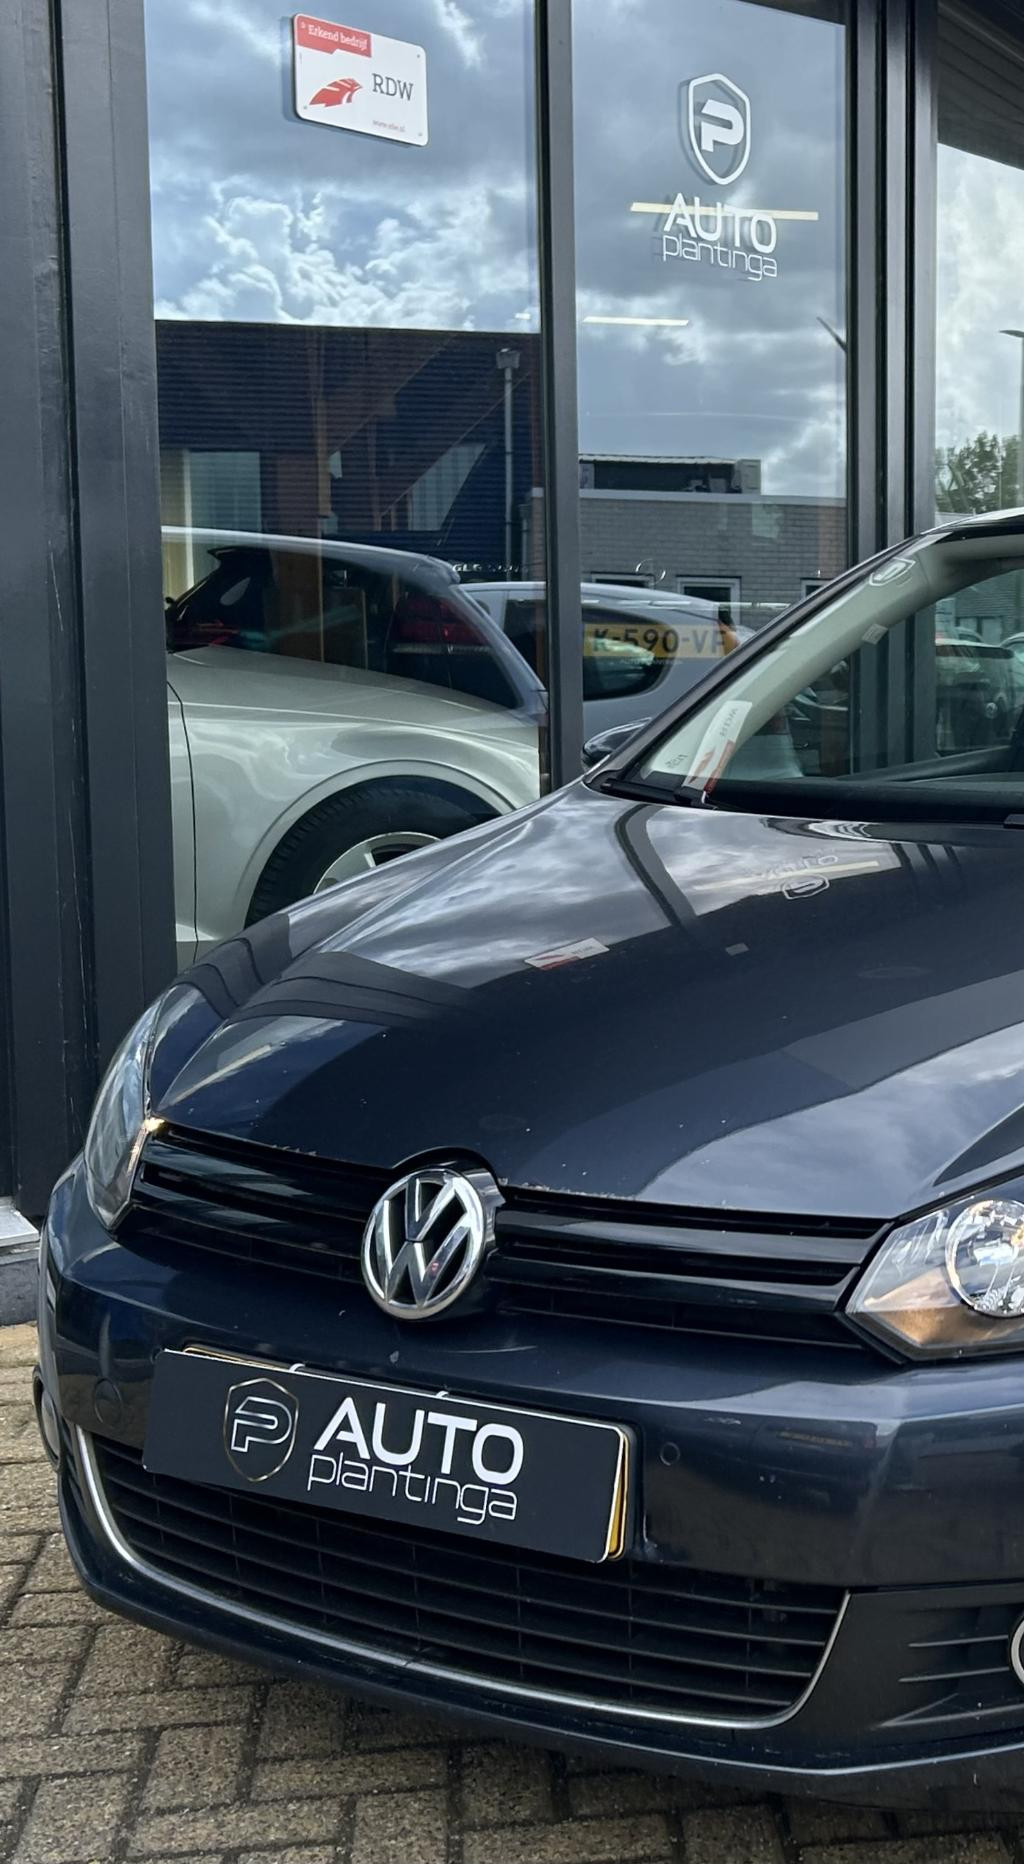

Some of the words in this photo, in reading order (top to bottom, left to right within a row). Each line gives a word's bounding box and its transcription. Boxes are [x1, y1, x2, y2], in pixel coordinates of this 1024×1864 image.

[308, 24, 339, 42] Erkend
[340, 32, 368, 51] bedrijf
[371, 73, 414, 101] RDW
[663, 192, 777, 254] AUTO
[663, 232, 778, 281] plantinga
[312, 1397, 524, 1485] AUTO
[307, 1452, 519, 1525] plantinga
